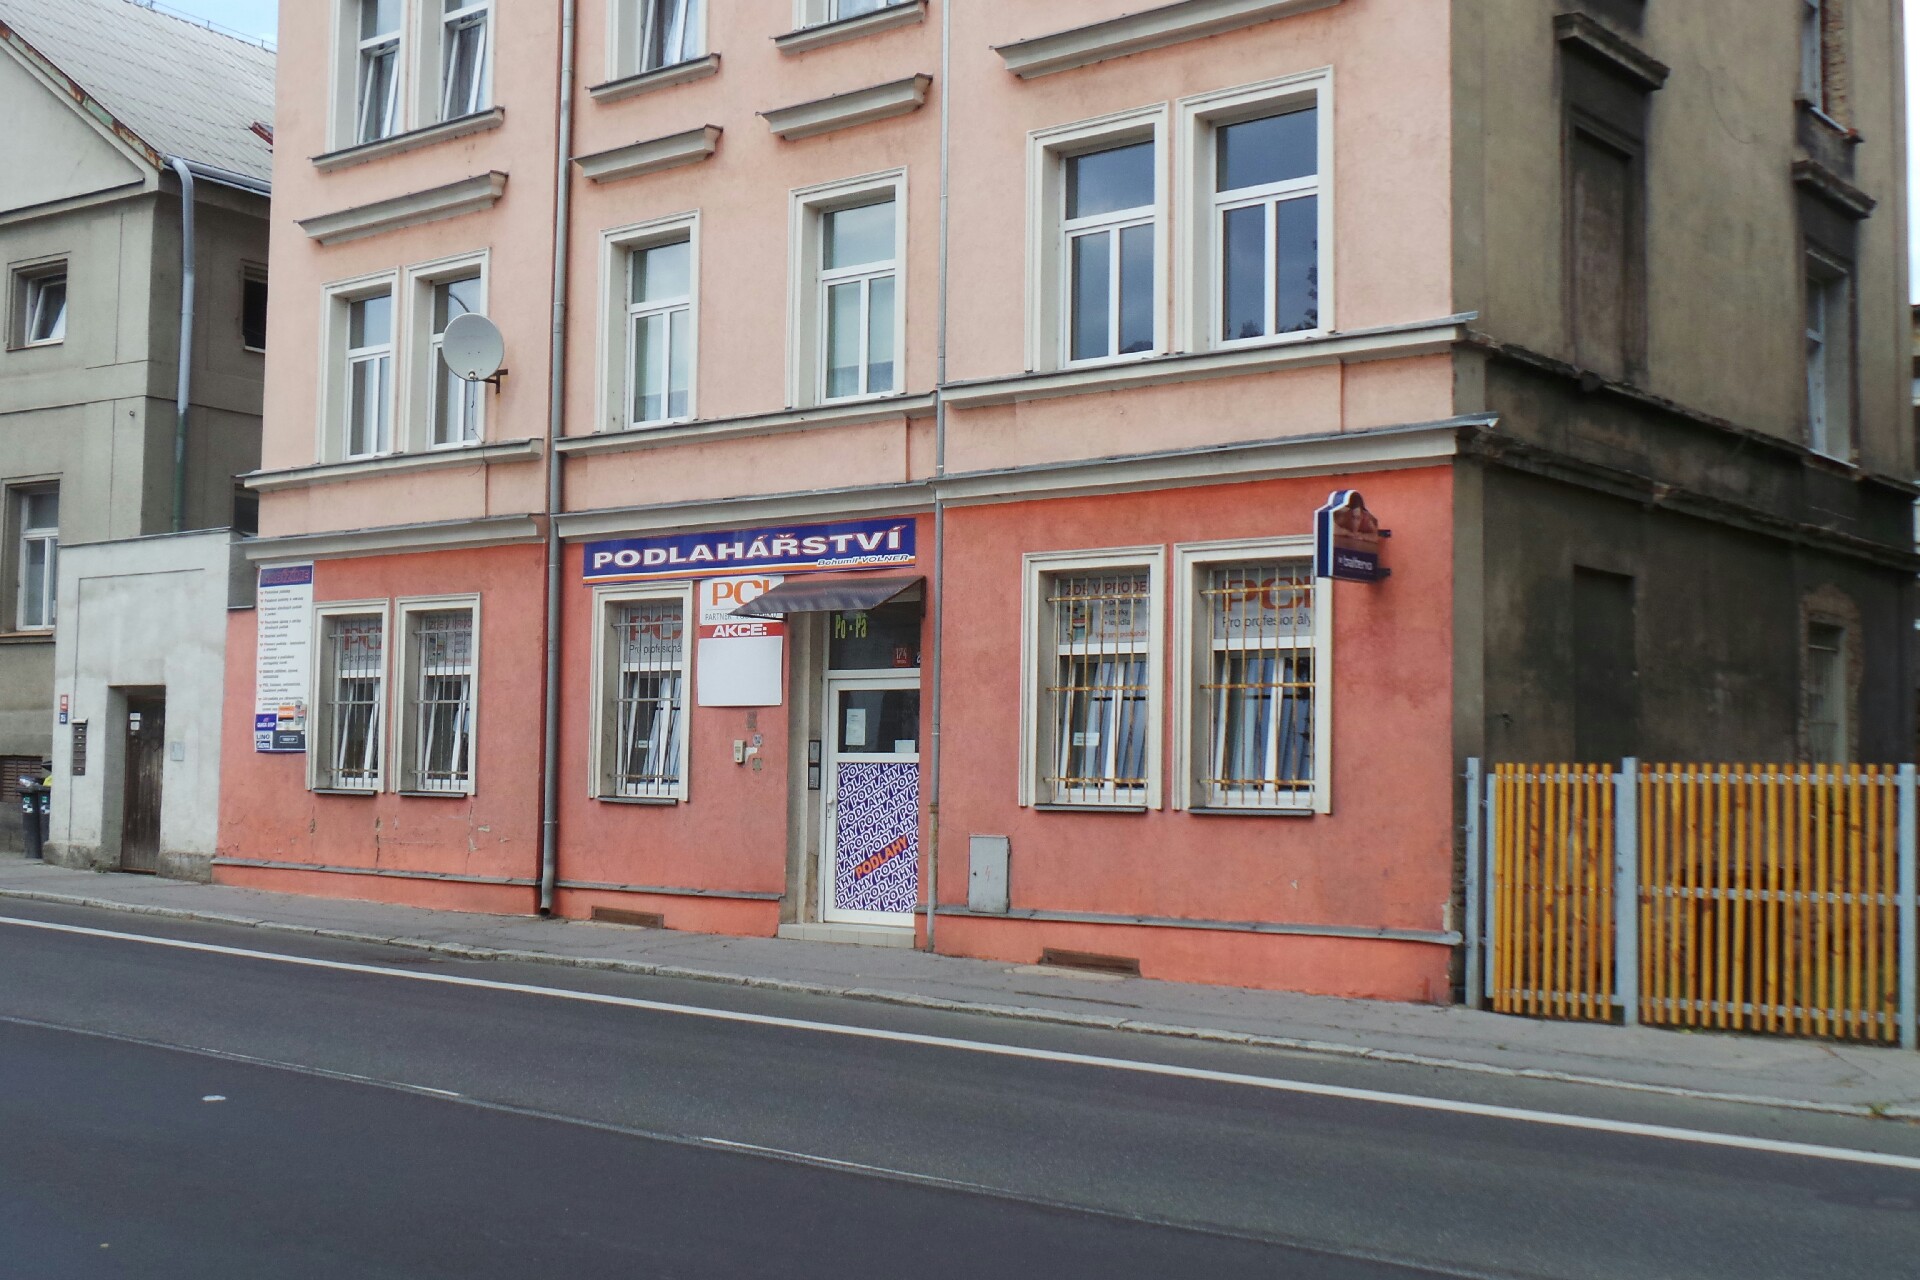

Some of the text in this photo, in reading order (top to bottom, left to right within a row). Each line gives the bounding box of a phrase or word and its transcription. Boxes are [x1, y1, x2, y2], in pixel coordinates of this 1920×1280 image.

[593, 525, 906, 569] PODLAHÁŘSTVÍ
[817, 554, 909, 566] Bohumil VOLNER
[1222, 576, 1311, 612] PCI
[705, 612, 732, 621] PARTNER
[712, 624, 768, 637] AKCE:
[835, 614, 846, 639] Po
[855, 612, 867, 638] Pá
[850, 764, 900, 806] PODLAHY
[840, 786, 890, 828] PODLAHY
[858, 788, 908, 831] PODLAHY
[848, 811, 898, 853] PODLAHY
[866, 813, 917, 855] PODLAHY
[855, 834, 908, 879] PODLAHY
[864, 862, 914, 903] PODLAHY
